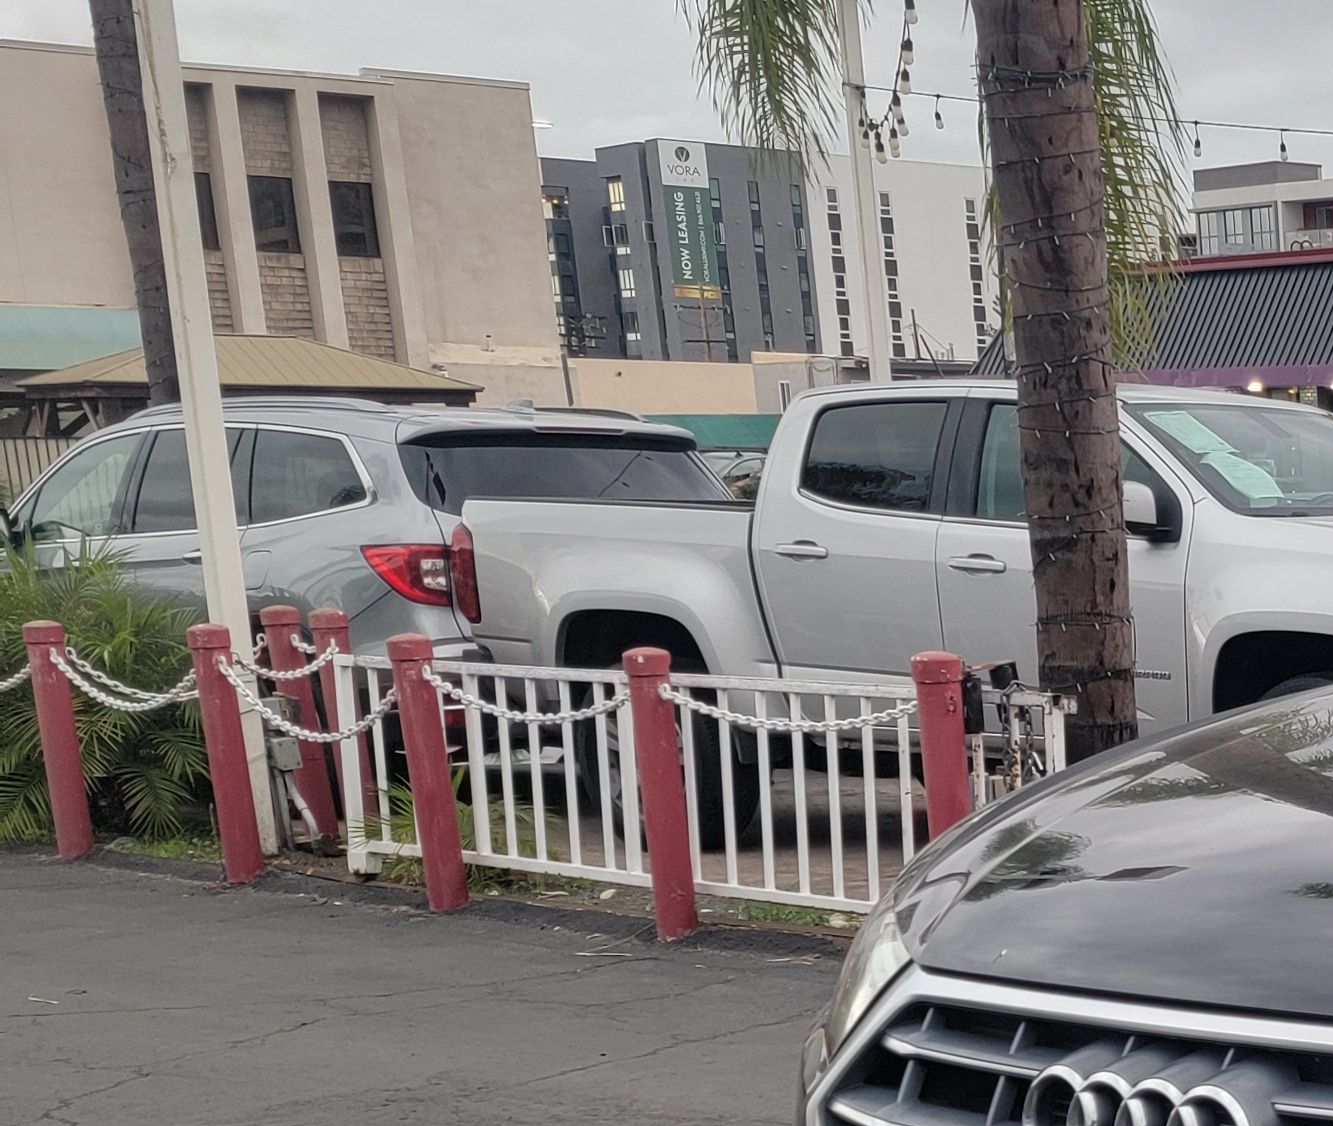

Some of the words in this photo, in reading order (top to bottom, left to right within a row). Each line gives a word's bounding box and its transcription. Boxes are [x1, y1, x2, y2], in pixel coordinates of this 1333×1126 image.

[666, 164, 701, 177] VORA
[673, 191, 689, 243] LEASING
[681, 248, 694, 280] NOW
